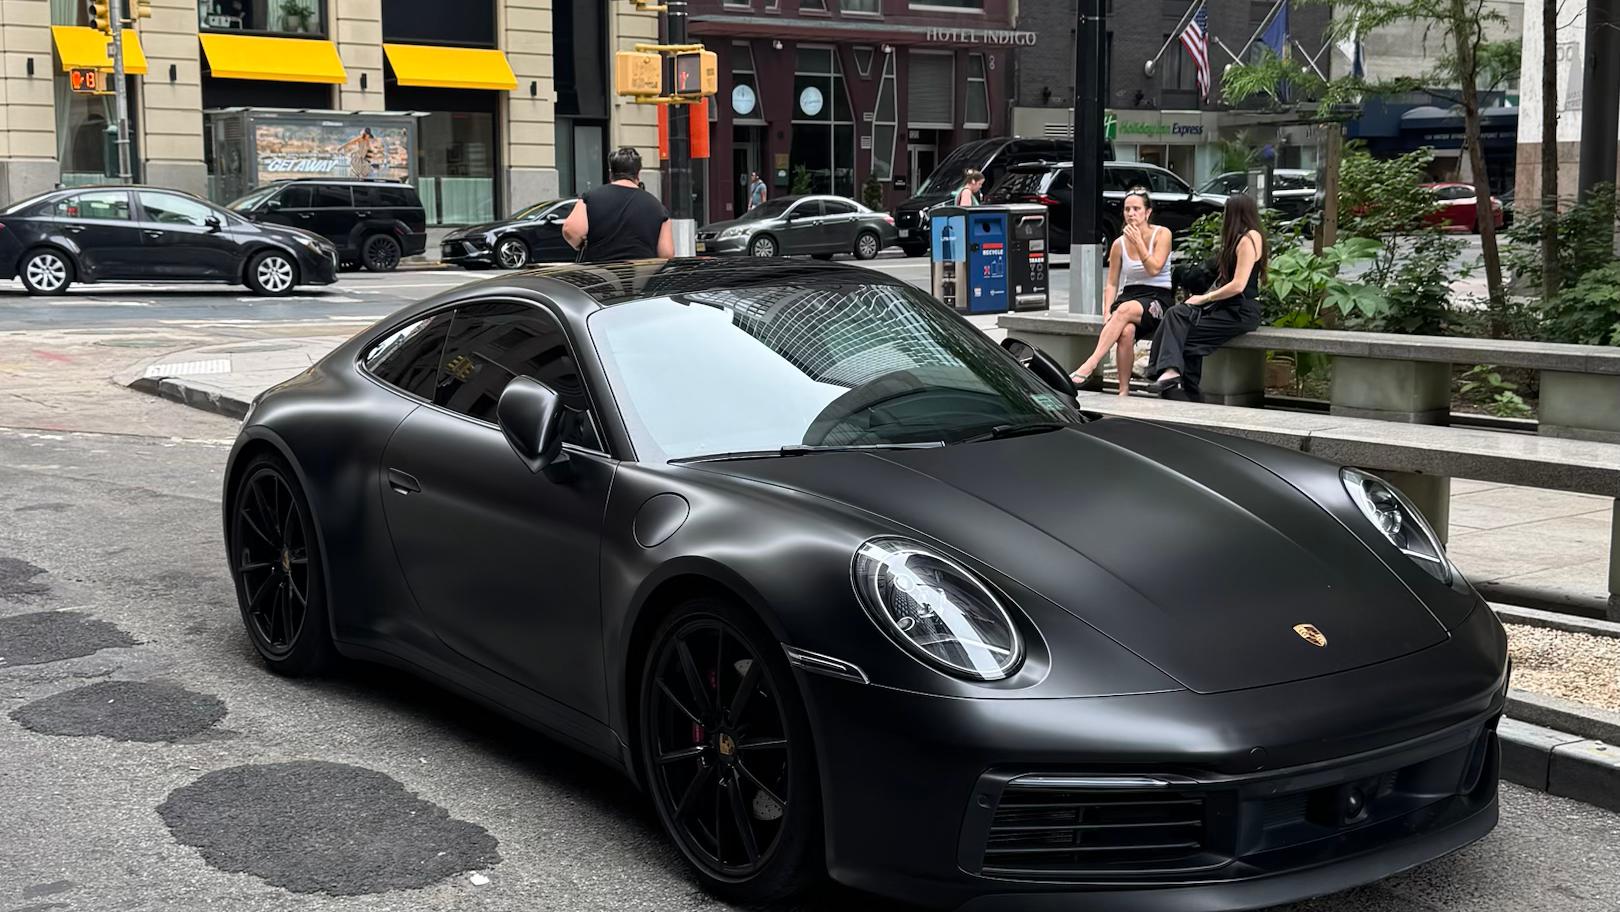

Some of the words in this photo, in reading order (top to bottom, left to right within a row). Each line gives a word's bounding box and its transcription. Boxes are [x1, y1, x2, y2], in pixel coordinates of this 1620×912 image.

[926, 27, 979, 43] HOTEL
[983, 29, 1037, 46] INDIGO
[86, 71, 96, 89] 13
[1172, 122, 1204, 137] Express
